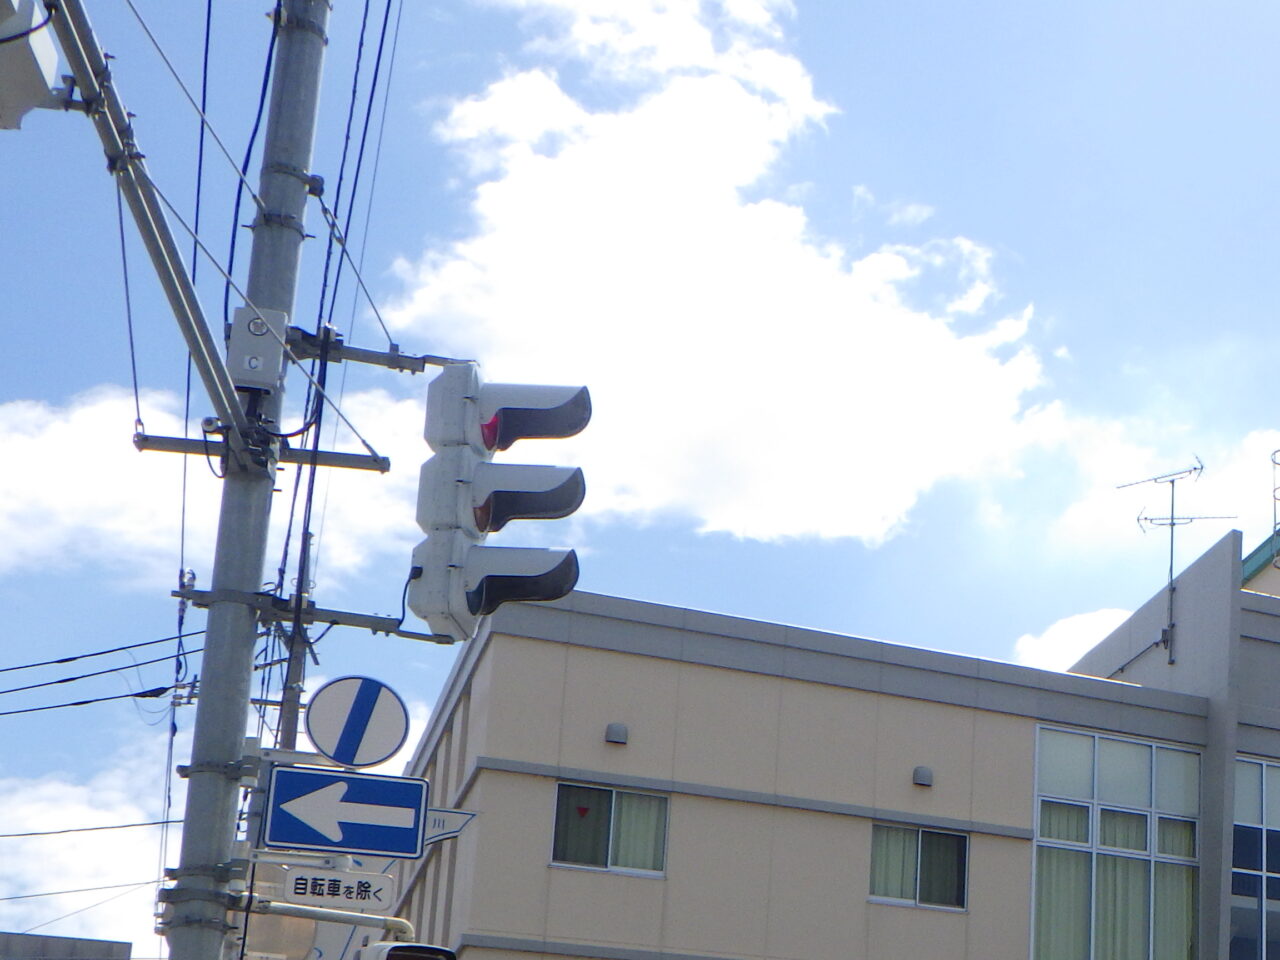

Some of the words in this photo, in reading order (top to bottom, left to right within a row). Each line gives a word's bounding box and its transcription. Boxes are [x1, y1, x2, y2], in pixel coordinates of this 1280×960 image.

[248, 356, 259, 370] C
[293, 876, 383, 902] 自転車を除く
